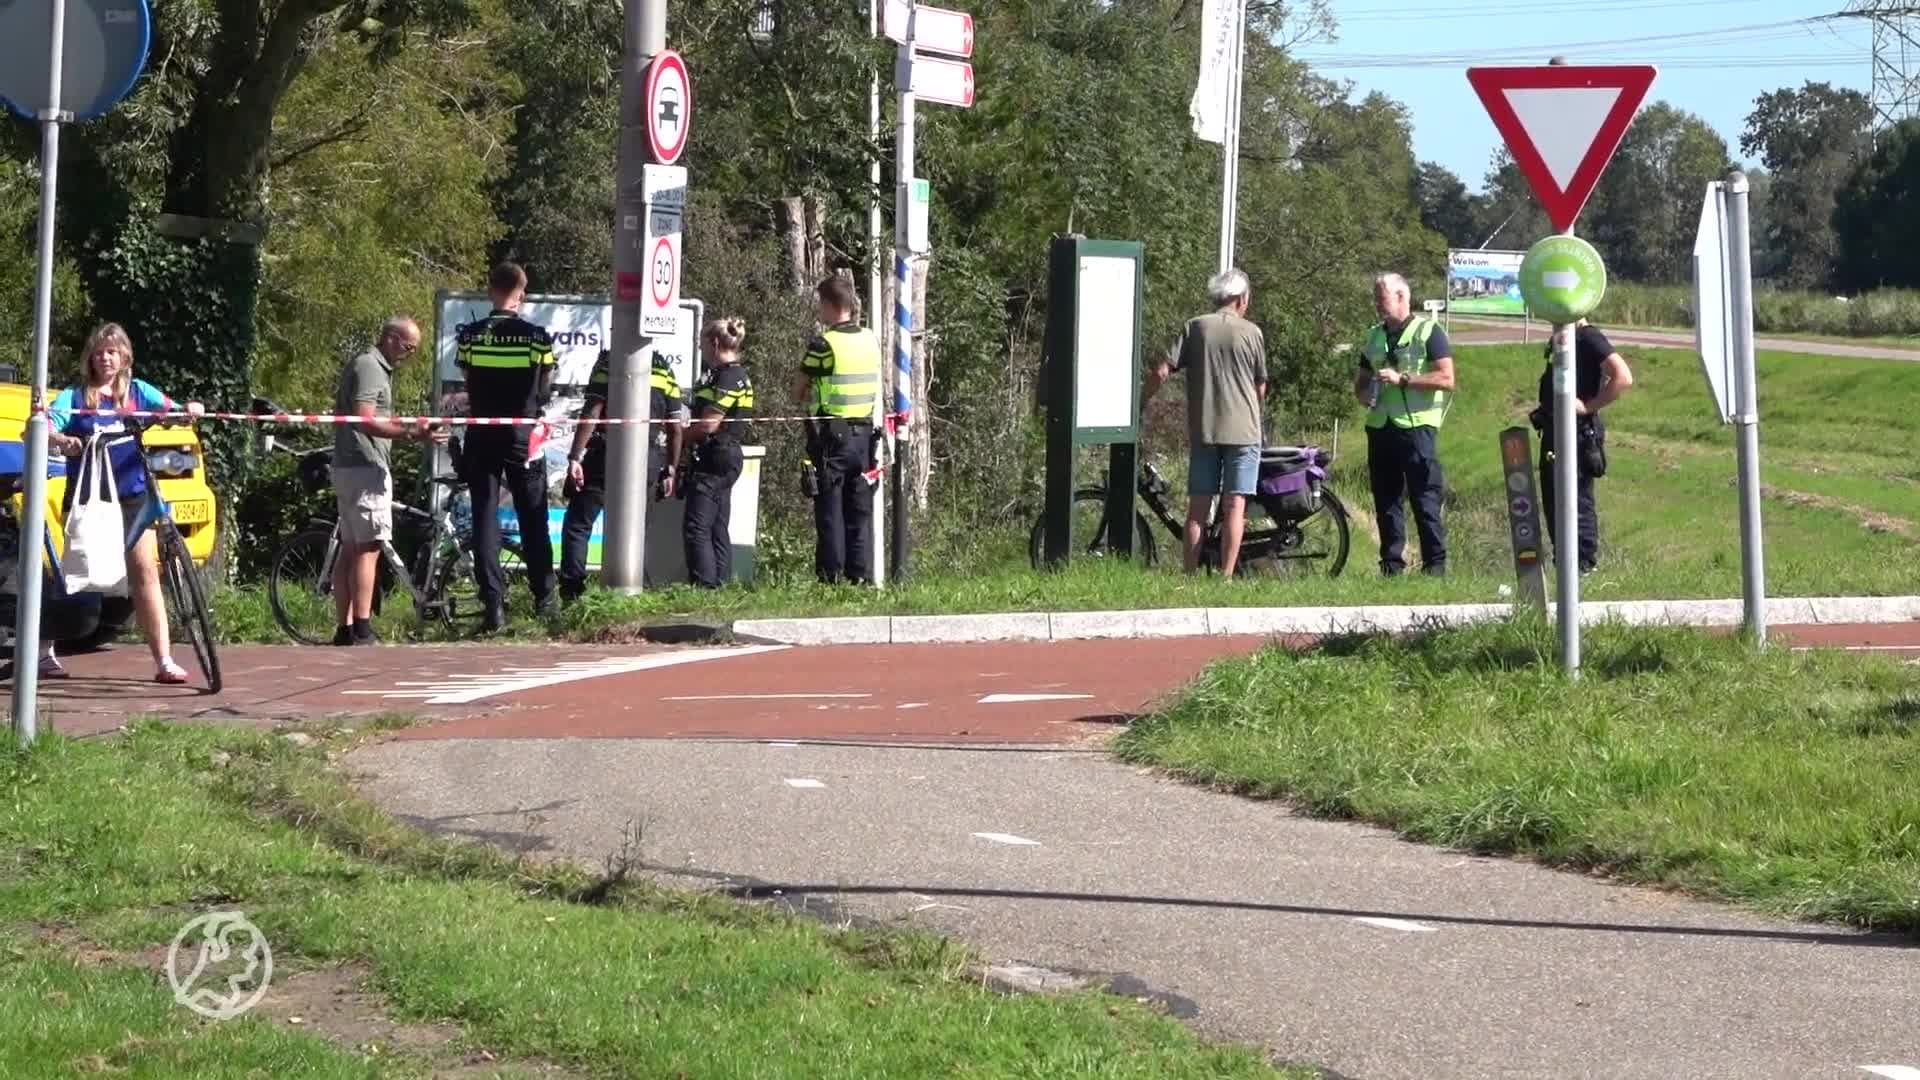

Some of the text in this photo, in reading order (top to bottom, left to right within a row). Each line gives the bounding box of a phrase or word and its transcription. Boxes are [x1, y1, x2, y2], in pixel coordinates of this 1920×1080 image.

[1453, 256, 1489, 266] Welkom
[655, 260, 671, 285] 30
[551, 331, 598, 346] vans
